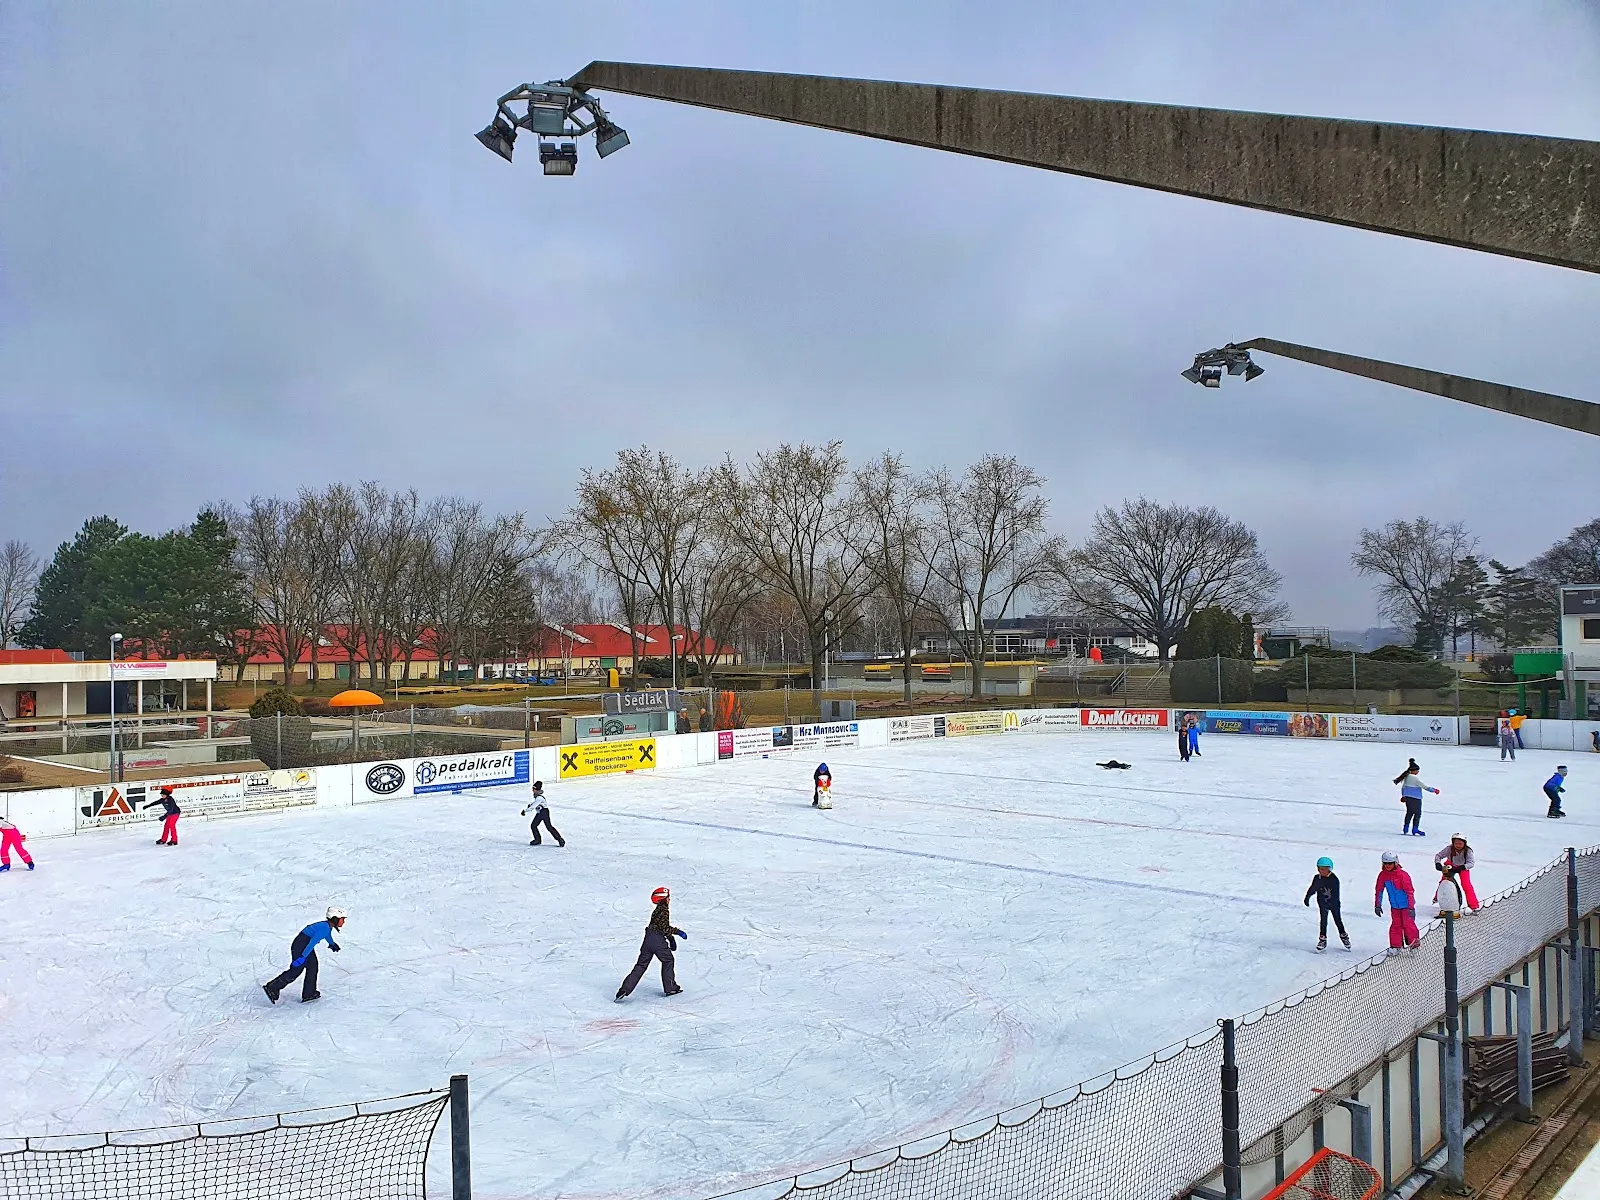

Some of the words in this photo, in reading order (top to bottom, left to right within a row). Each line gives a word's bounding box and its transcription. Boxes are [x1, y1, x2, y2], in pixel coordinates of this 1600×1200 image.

[624, 692, 663, 707] Sedlak
[1338, 716, 1375, 724] PESEK
[584, 755, 634, 765] Raiffeisenbank
[438, 755, 514, 777] pedalkraft
[594, 763, 628, 772] Stockerau
[80, 787, 146, 817] JAF
[108, 813, 146, 822] FRISCHEIS
